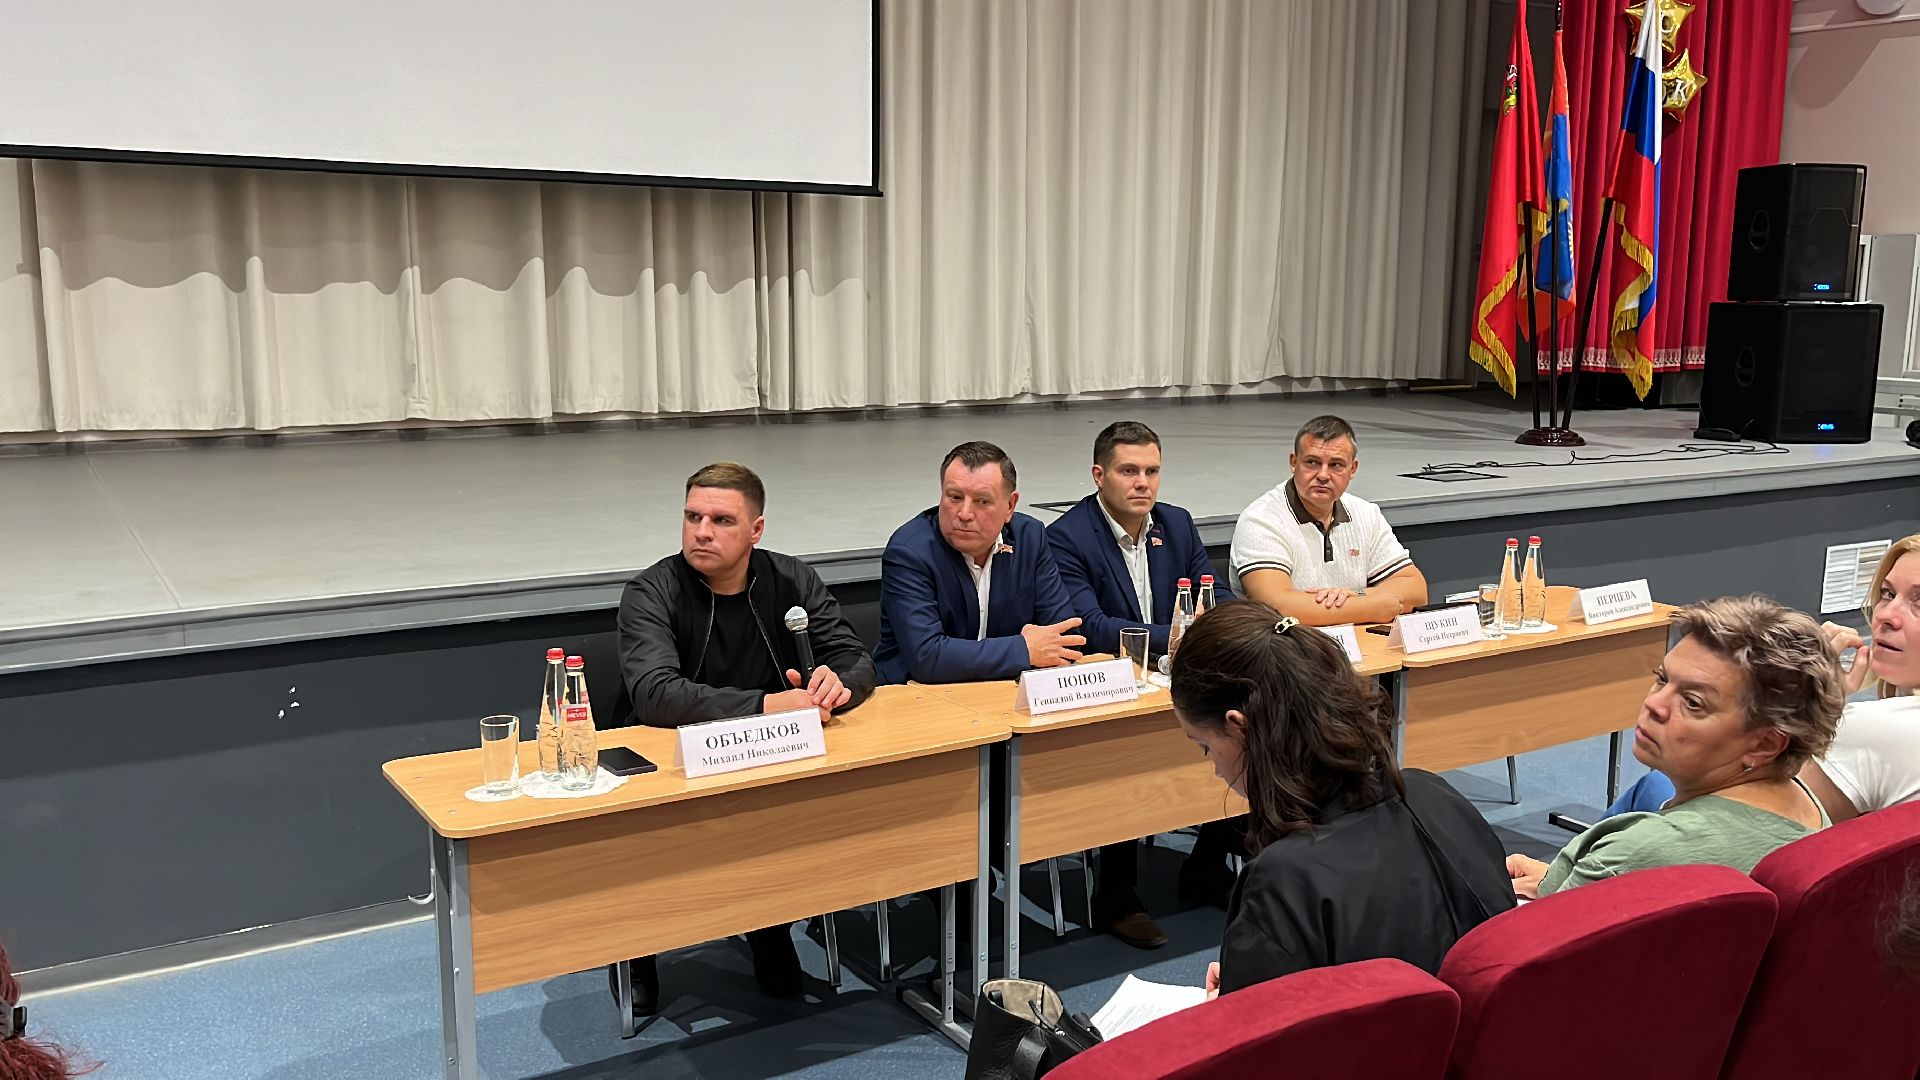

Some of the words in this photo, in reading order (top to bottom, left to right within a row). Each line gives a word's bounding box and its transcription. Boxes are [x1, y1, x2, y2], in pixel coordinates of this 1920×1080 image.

[1596, 590, 1637, 606] ПЕРЦЕВА
[1424, 617, 1458, 630] ЩУКИН
[1419, 634, 1440, 644] Сергей
[1057, 672, 1106, 688] ПОПОВ
[1033, 694, 1074, 707] Геннадий
[1076, 686, 1134, 698] Владимирович
[705, 722, 800, 749] ОБЪЕДКОВ
[702, 752, 745, 767] Михаил
[747, 742, 809, 759] Николаевич
